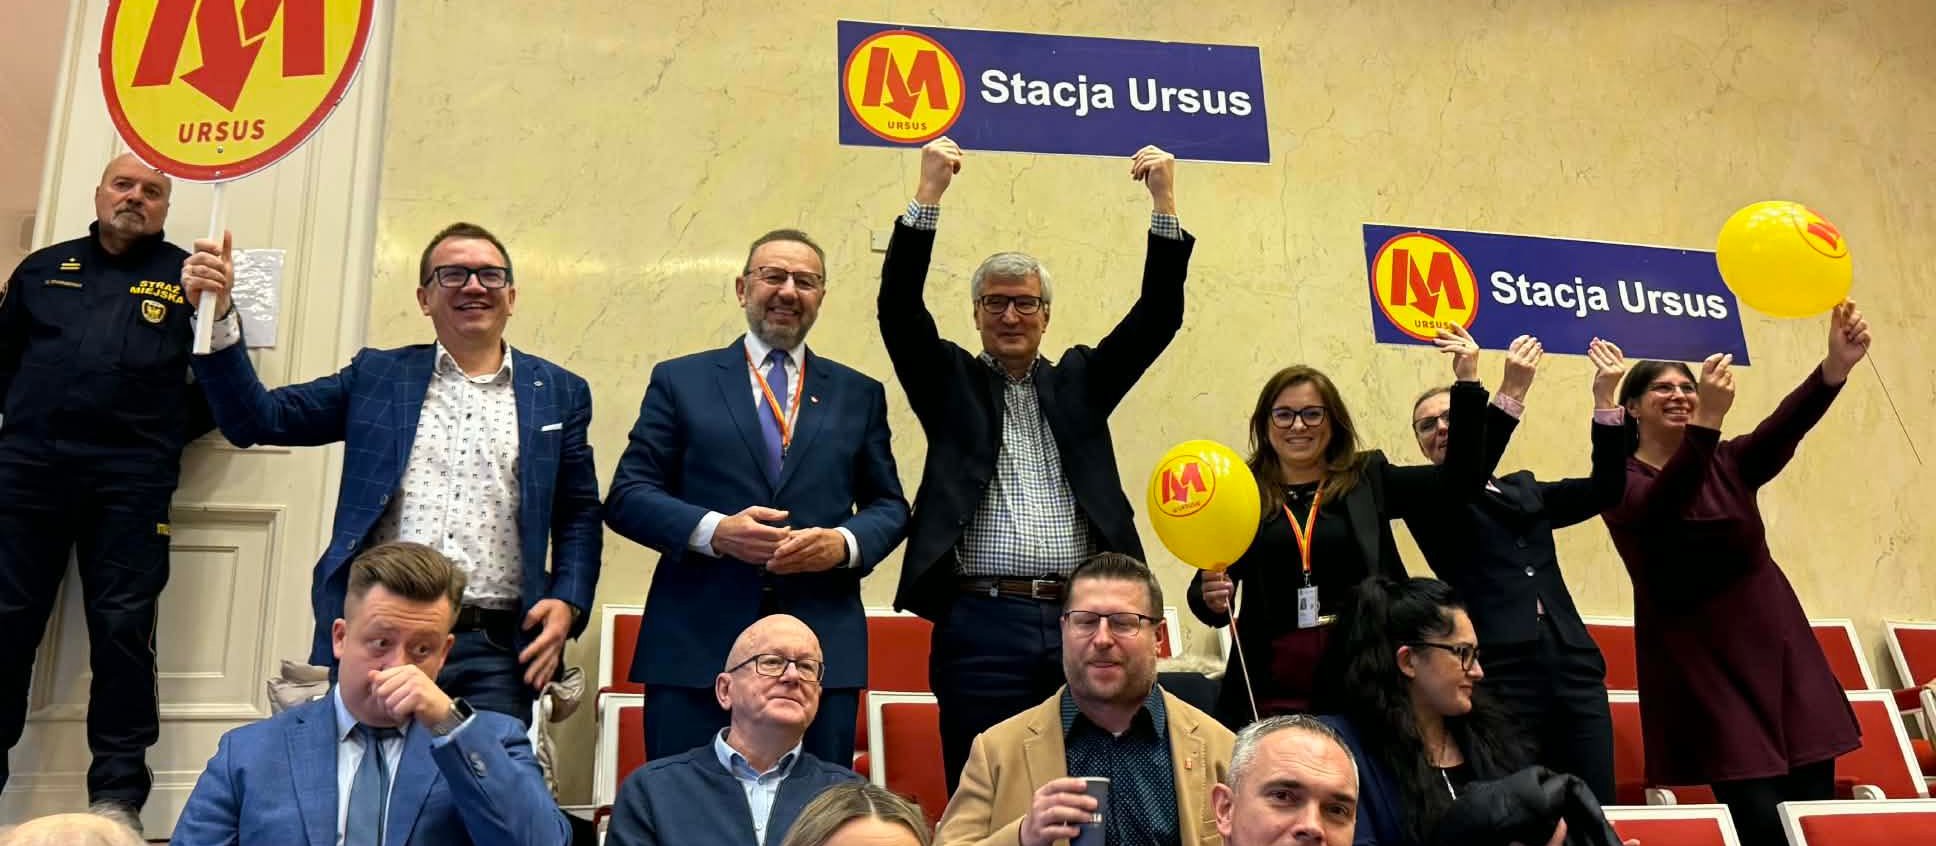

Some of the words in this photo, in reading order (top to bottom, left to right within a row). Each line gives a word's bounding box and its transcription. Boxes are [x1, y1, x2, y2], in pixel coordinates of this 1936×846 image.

[980, 68, 1115, 117] Stacja
[1128, 77, 1252, 117] Ursus
[178, 118, 266, 144] URSUS
[887, 120, 928, 131] URSUS
[129, 286, 185, 304] MIEJSKA
[1490, 270, 1610, 318] Stacja
[1617, 279, 1728, 320] Ursus
